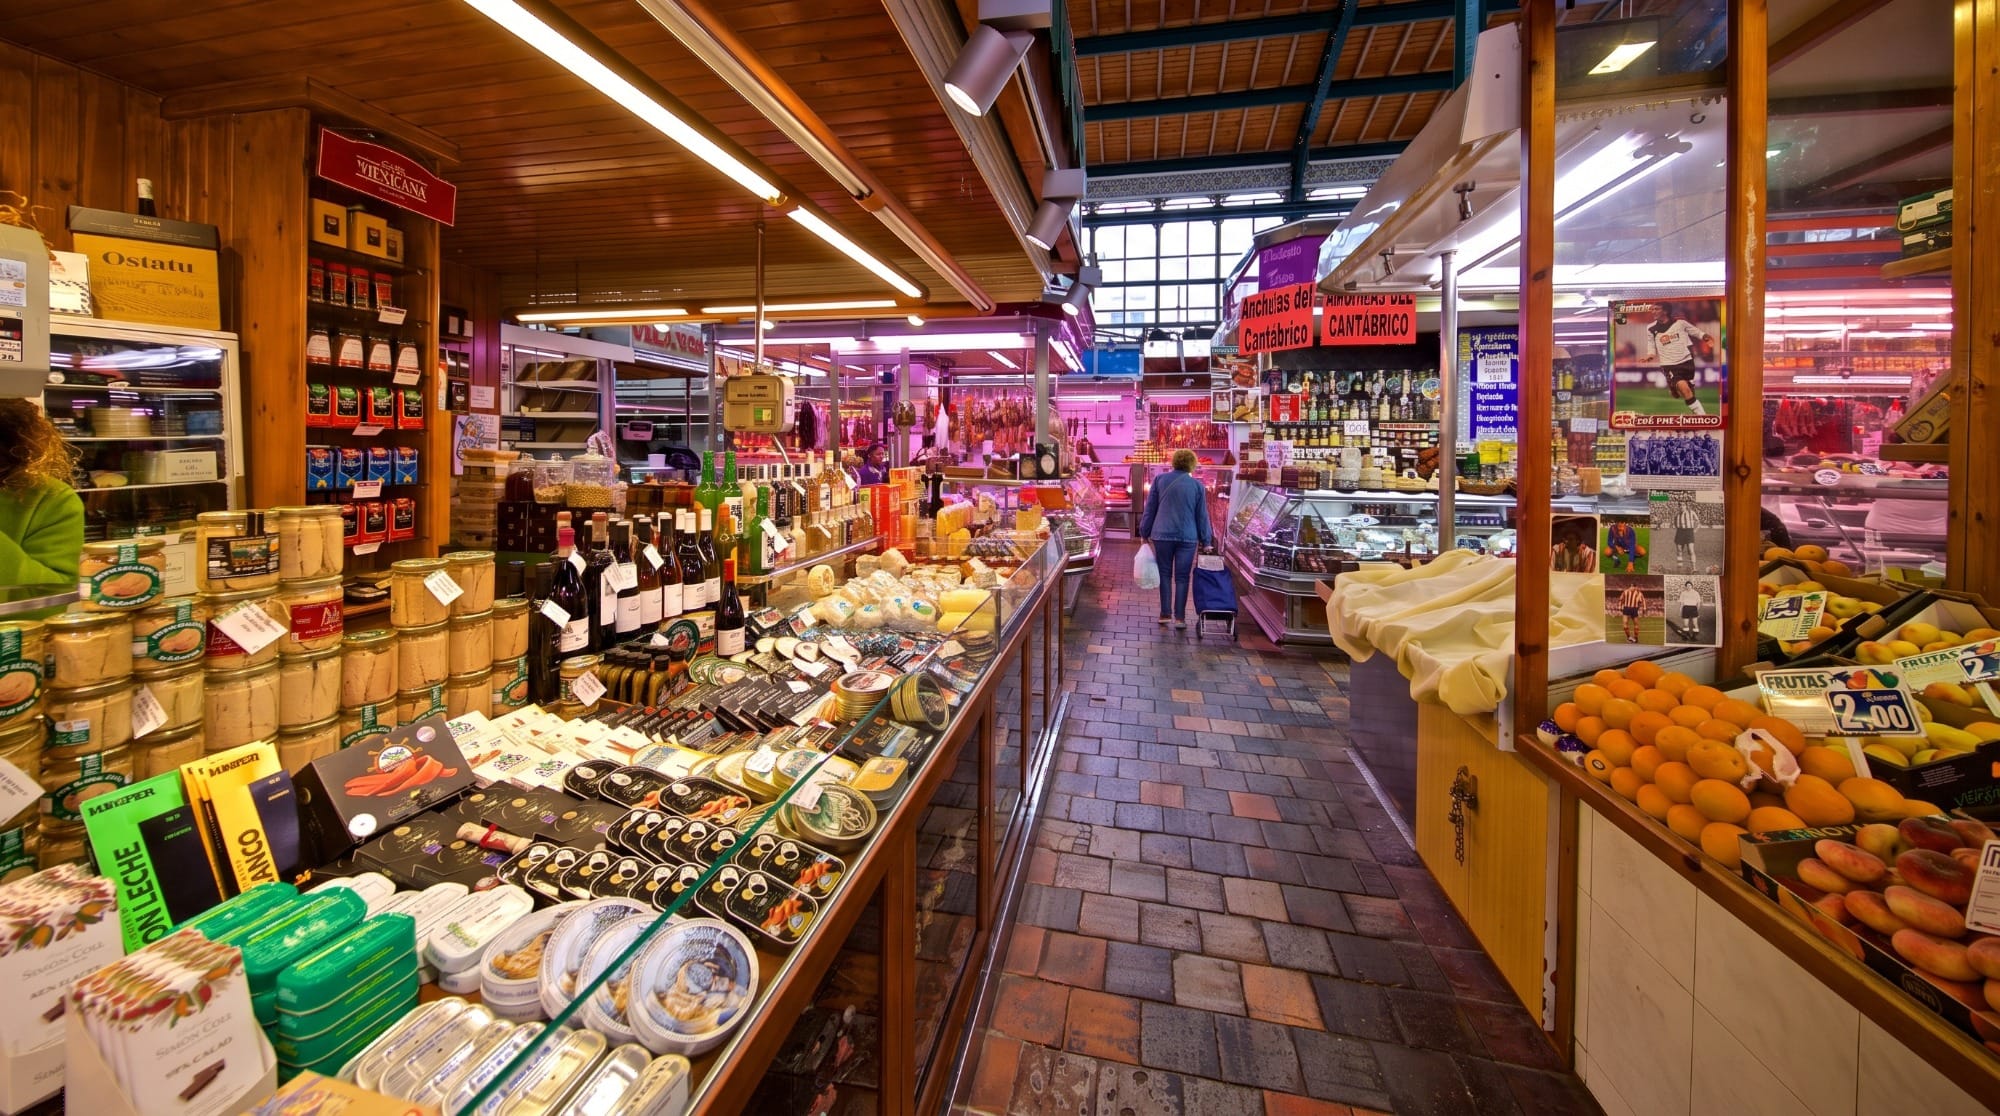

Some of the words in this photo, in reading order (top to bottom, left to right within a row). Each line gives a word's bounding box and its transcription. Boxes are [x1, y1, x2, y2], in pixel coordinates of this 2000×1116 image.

[101, 251, 193, 274] Ostatu
[1294, 284, 1313, 309] del
[1244, 319, 1308, 353] Cantábrico
[1329, 310, 1409, 337] CANTÁBRICO
[1900, 650, 1960, 668] FRUTAS
[1765, 674, 1829, 689] FRUTAS
[1833, 693, 1910, 731] 2,00
[238, 828, 277, 884] ANCO
[113, 840, 159, 913] LECHE
